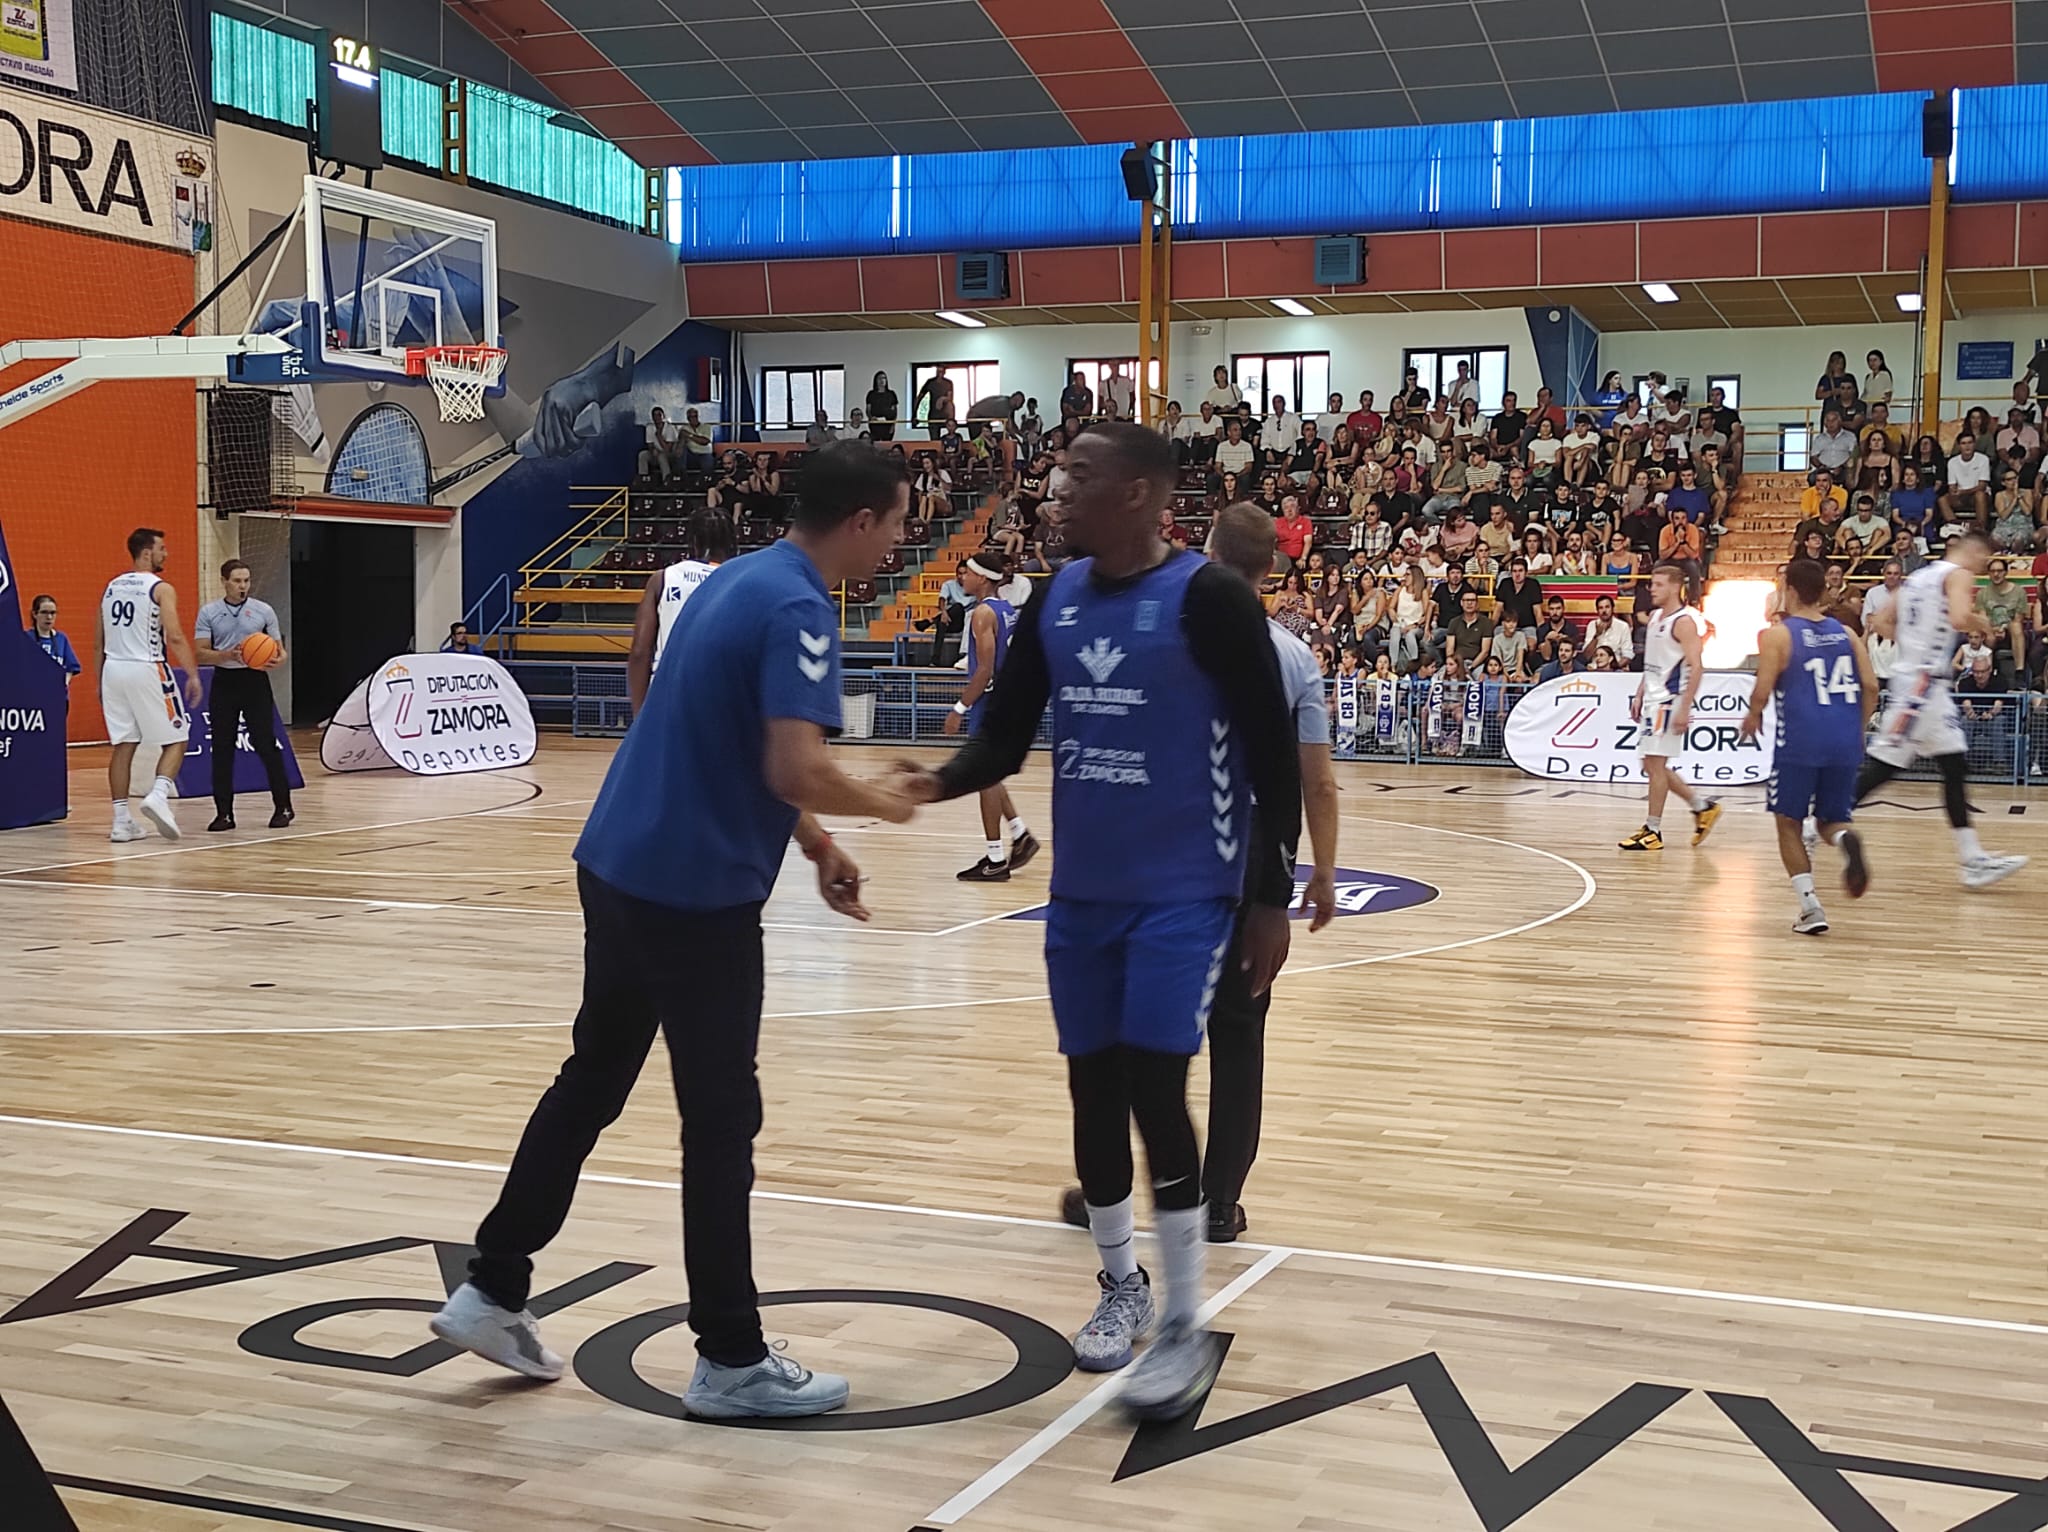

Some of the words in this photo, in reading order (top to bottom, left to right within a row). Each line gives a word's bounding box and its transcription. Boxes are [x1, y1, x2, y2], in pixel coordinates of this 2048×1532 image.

[29, 373, 64, 395] Sports
[111, 600, 135, 627] 99
[1803, 655, 1861, 705] 14
[427, 703, 511, 735] ZAMORA
[402, 743, 520, 771] Deportes
